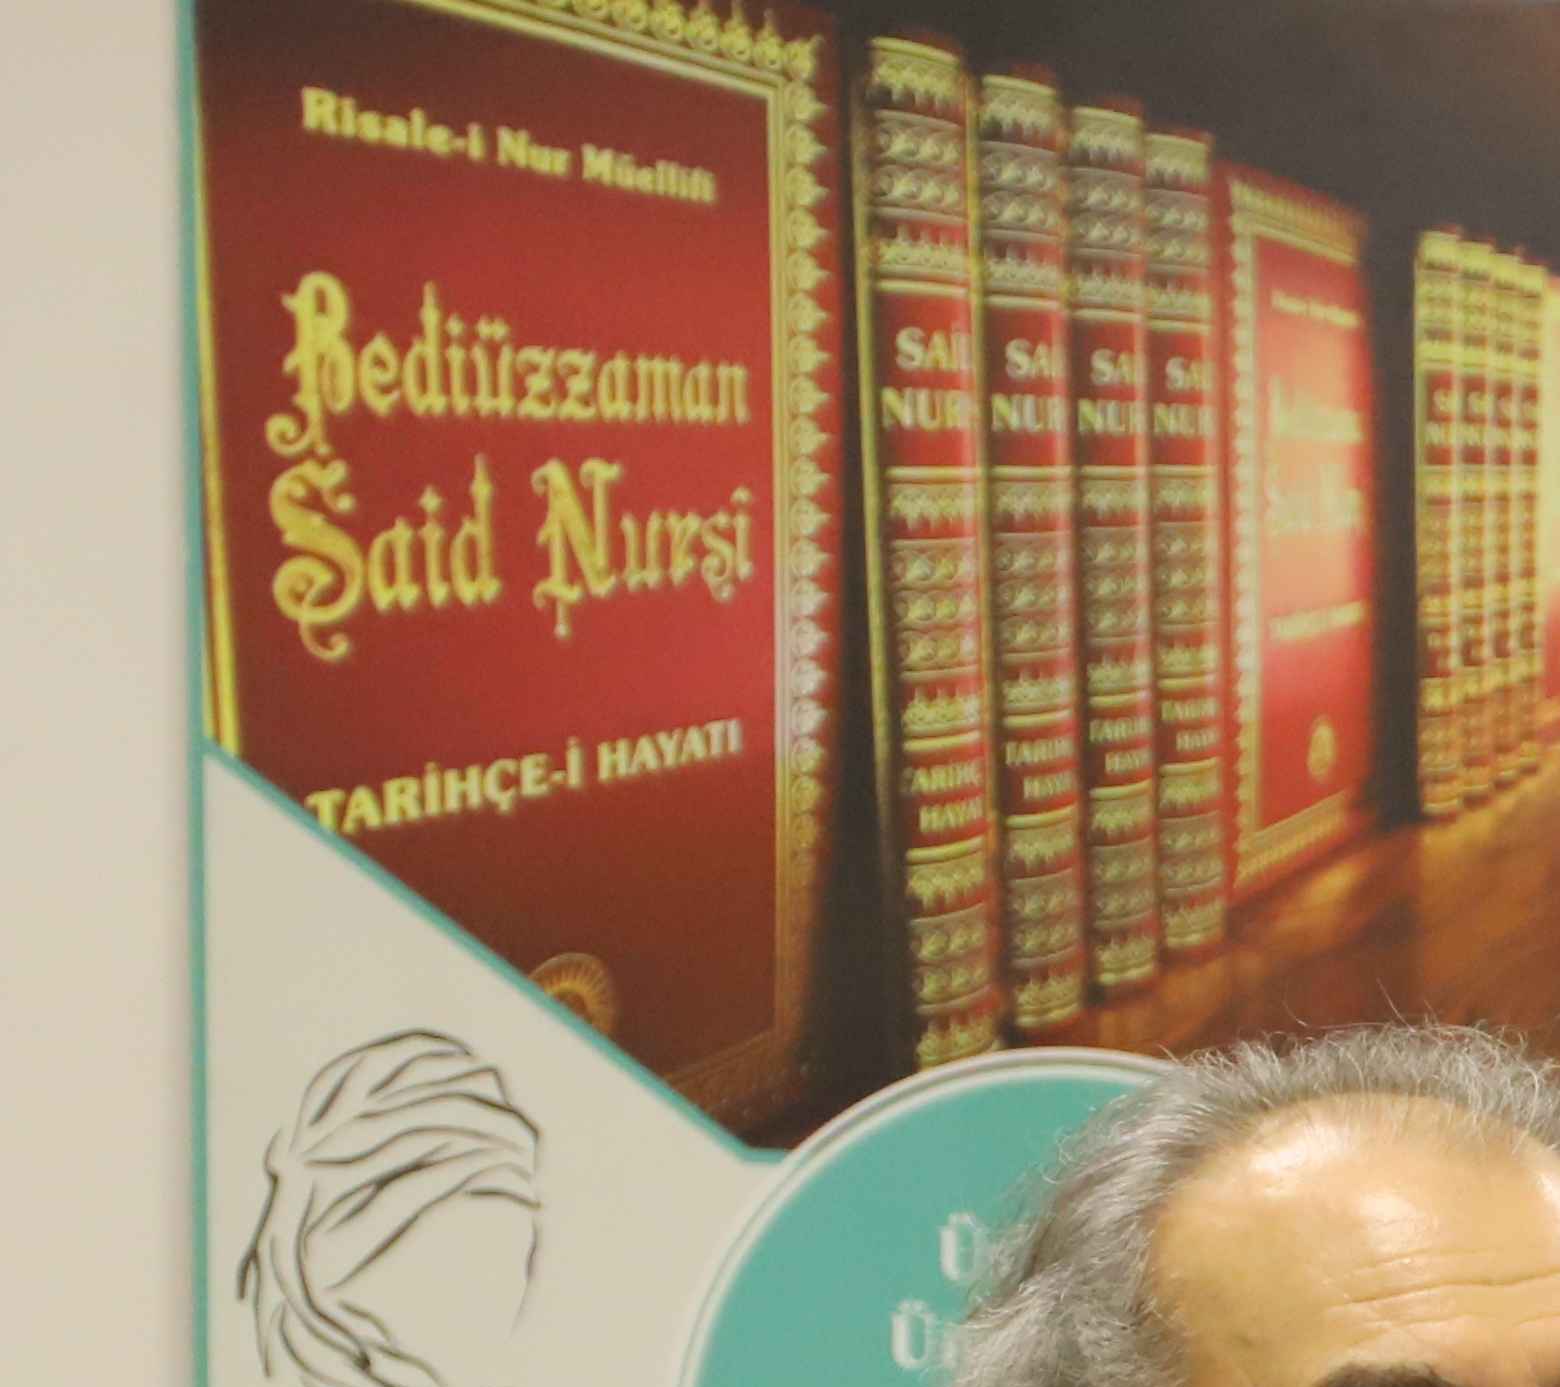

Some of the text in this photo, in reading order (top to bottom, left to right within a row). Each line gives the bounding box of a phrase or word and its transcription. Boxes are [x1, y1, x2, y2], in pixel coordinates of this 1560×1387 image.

[498, 125, 571, 176] Nur
[265, 271, 752, 456] Bediüzzaman
[269, 458, 499, 660] Said
[304, 717, 743, 835] TARİHÇE-İ HAYATI
